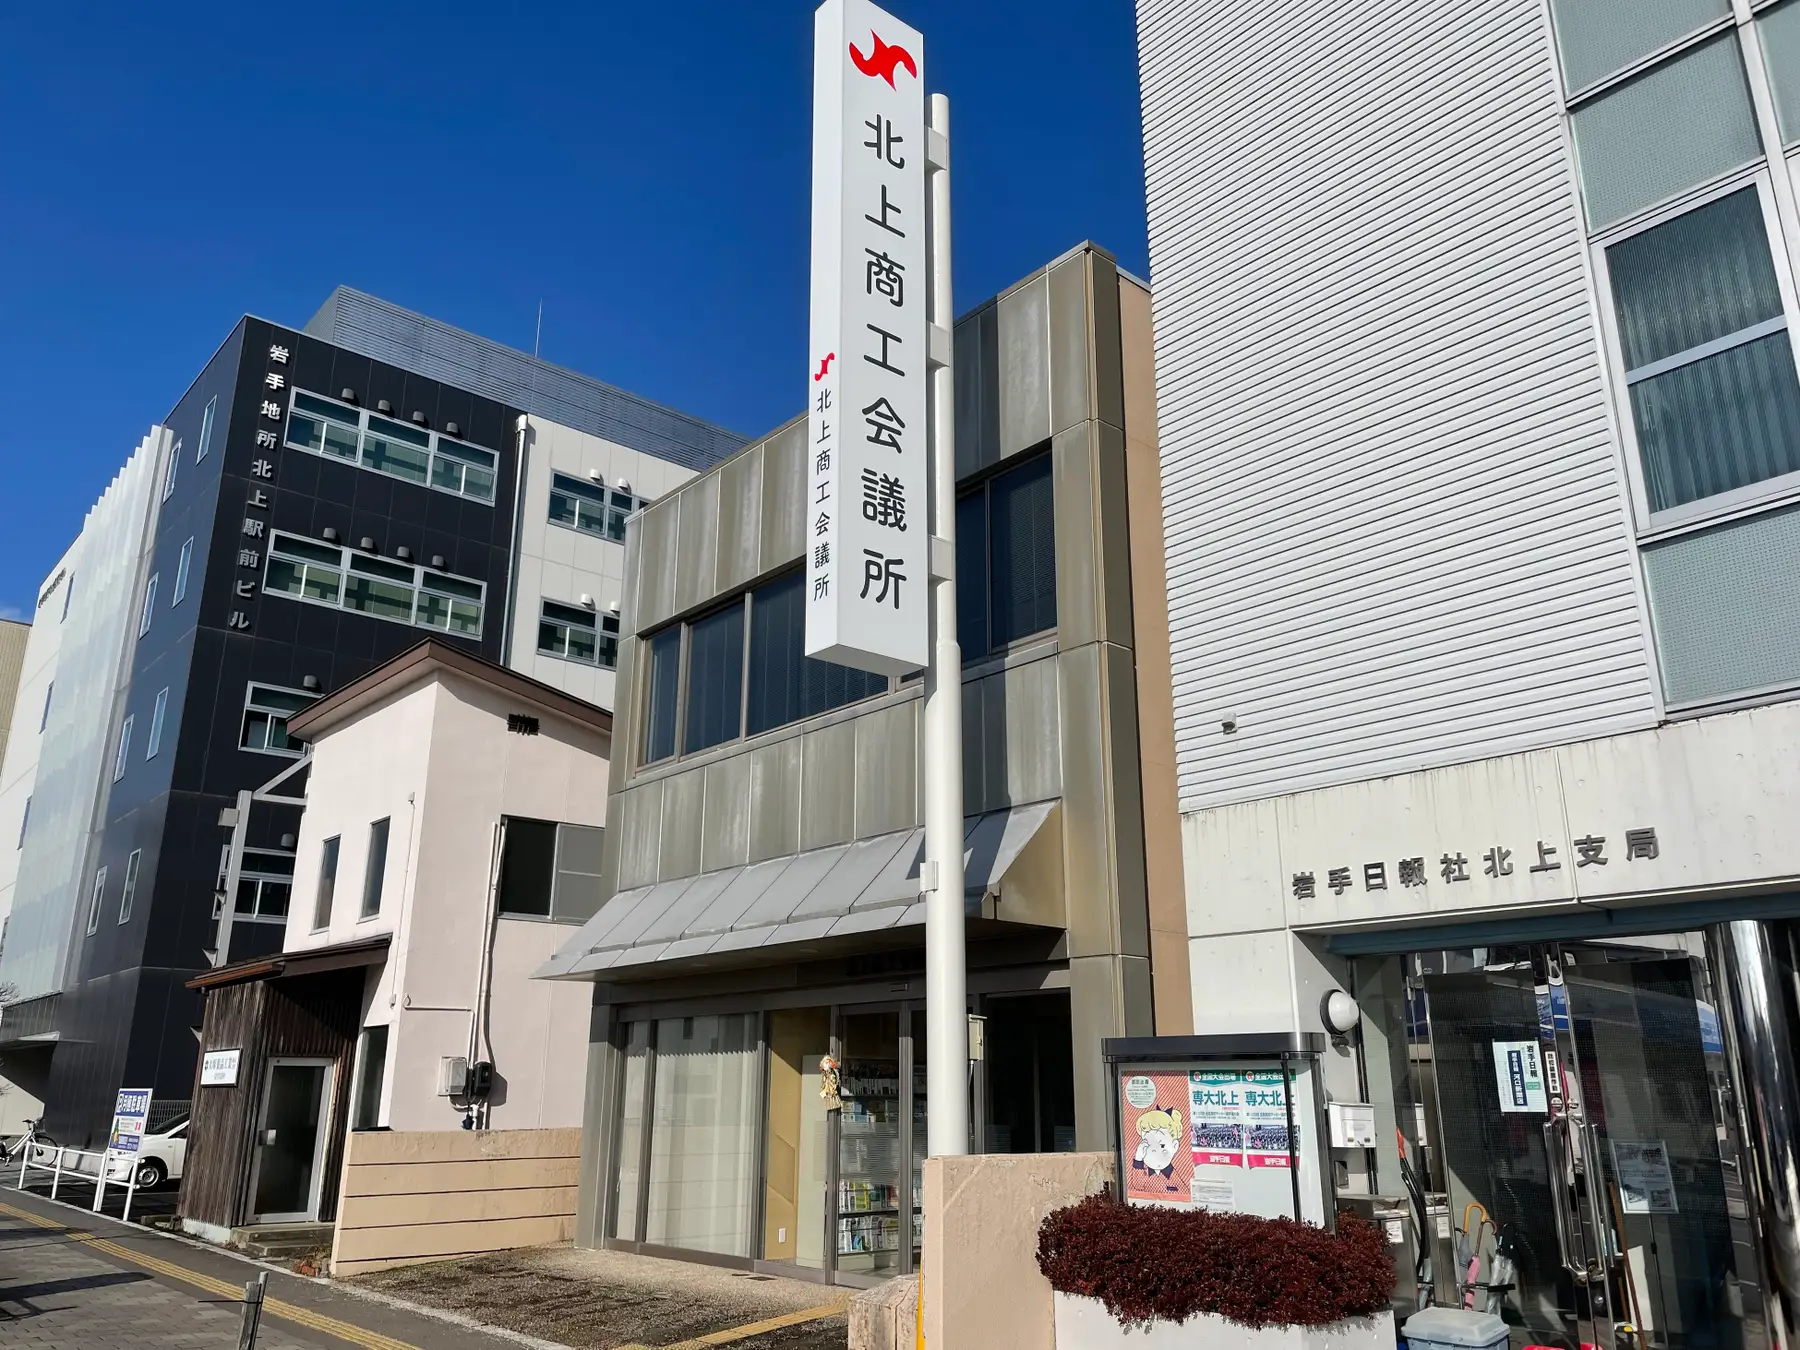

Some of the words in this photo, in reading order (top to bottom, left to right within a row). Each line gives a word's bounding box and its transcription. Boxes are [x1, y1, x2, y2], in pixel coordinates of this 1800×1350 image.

[860, 113, 907, 610] 北上商工会議所
[229, 344, 290, 630] 岩手地所北上駅前ビル
[813, 388, 832, 602] 北上商工会議所
[1292, 826, 1661, 900] 岩手日報社北上支局
[1192, 1090, 1240, 1106] 専大北上
[1255, 1072, 1284, 1081] 全国大会出
